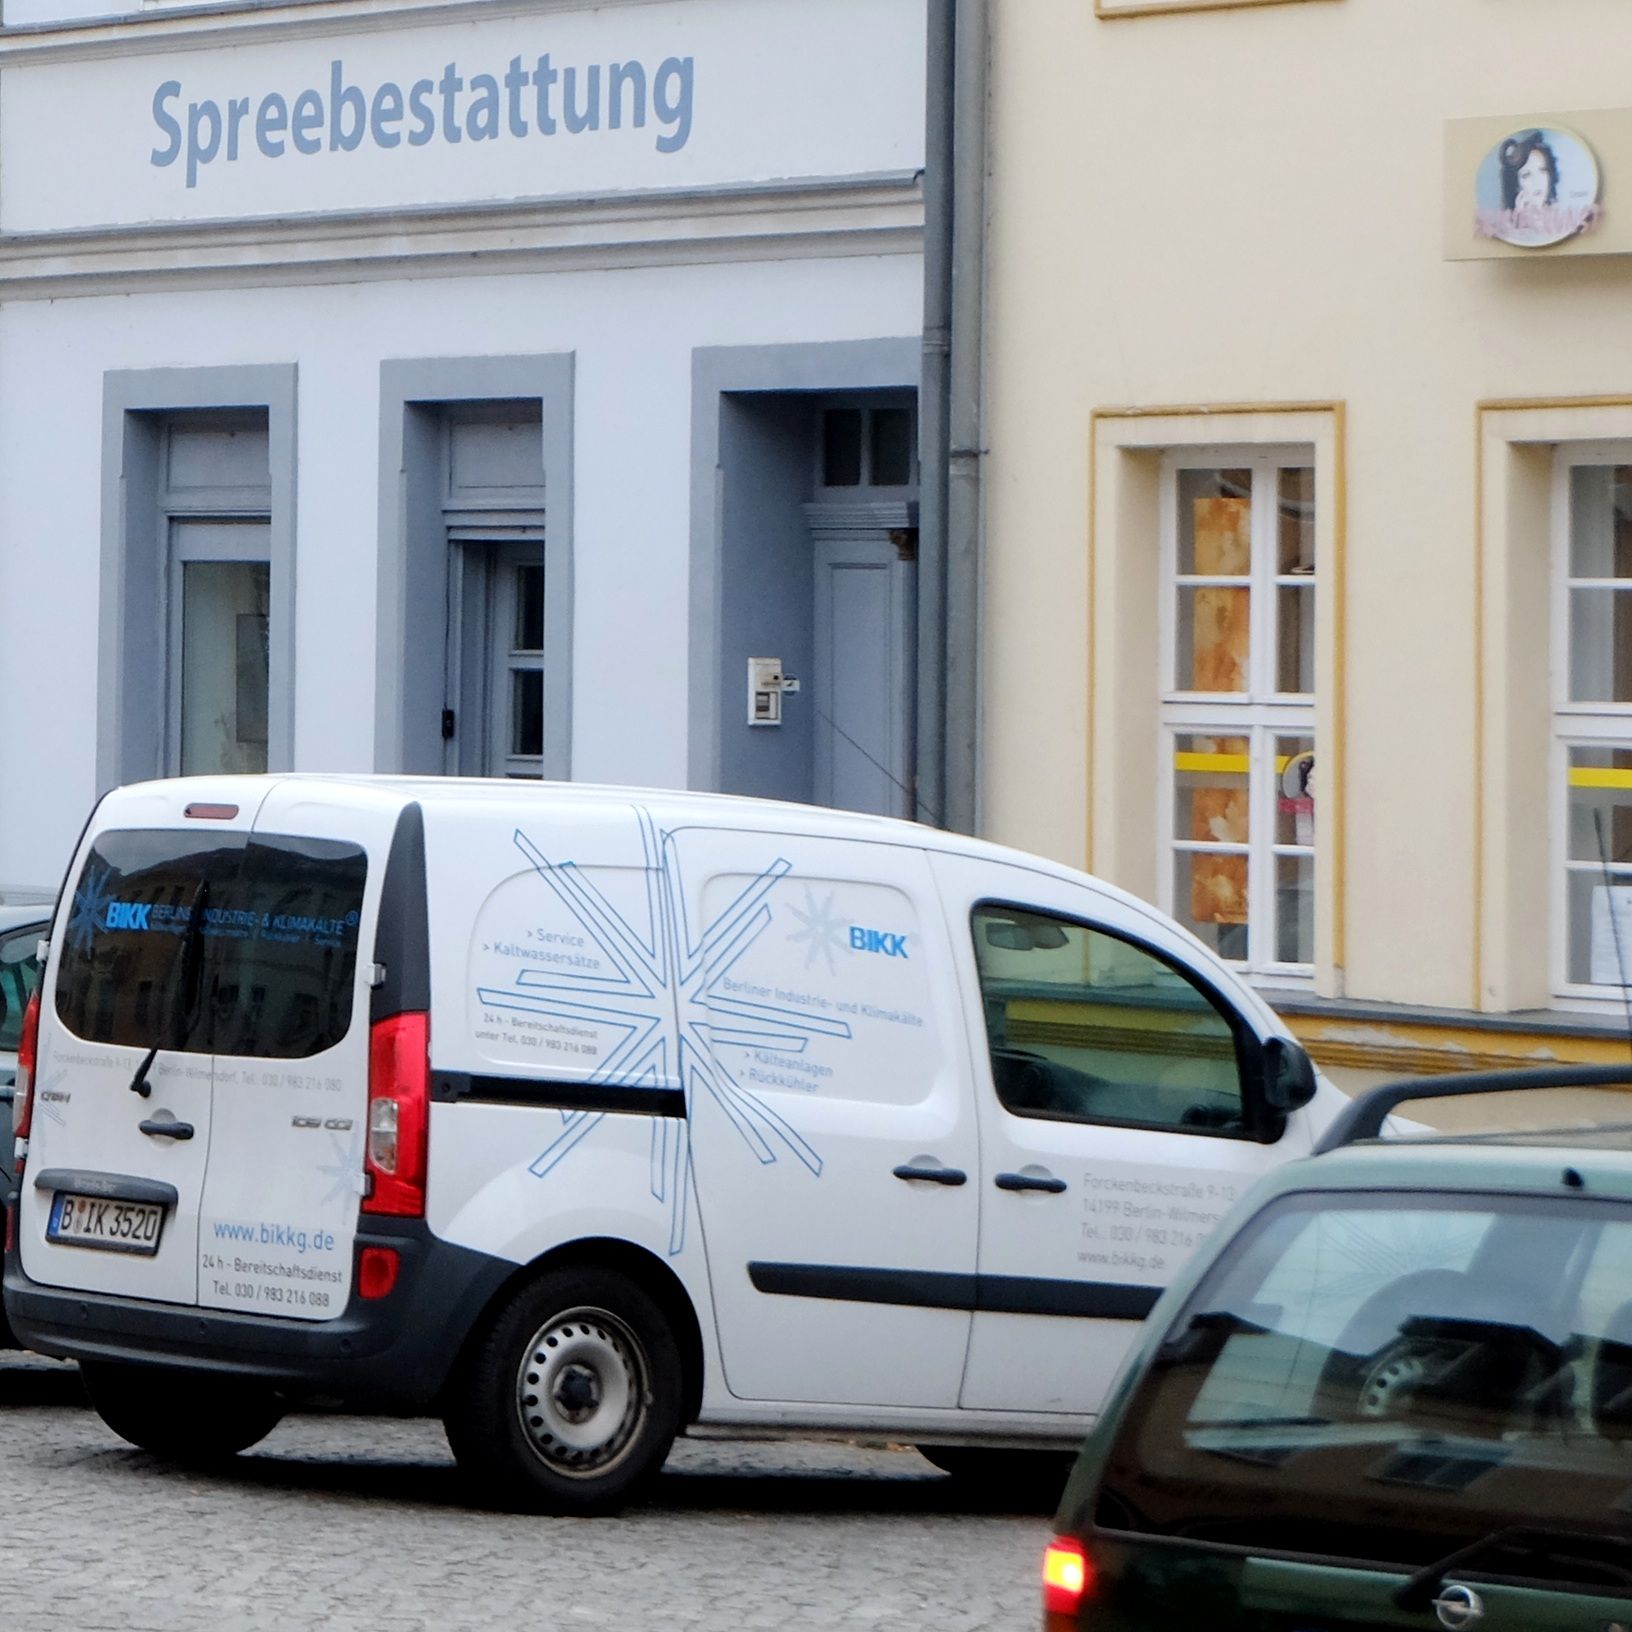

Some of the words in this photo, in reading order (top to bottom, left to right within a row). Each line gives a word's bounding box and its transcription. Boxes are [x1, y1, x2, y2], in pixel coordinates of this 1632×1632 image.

[149, 52, 694, 189] Spreebestattung
[106, 901, 152, 930] BIKK
[151, 904, 194, 921] BERLINE
[536, 927, 584, 948] Service
[849, 925, 909, 959] BIKK
[493, 941, 600, 969] Kaltwassersätze
[722, 976, 772, 998] Berliner
[775, 987, 833, 1009] Industrie-
[836, 1000, 857, 1014] und
[860, 1001, 924, 1028] Klimakälte
[475, 1029, 499, 1041] unter
[520, 1034, 537, 1047] 030
[482, 1012, 494, 1024] 24
[511, 1016, 598, 1040] Bereitschaftsdienst
[754, 1050, 834, 1078] Kälteanlagen
[749, 1067, 819, 1093] Rückkühler
[60, 1199, 74, 1230] B
[83, 1201, 110, 1235] IK
[109, 1205, 158, 1242] 3520
[1123, 1200, 1223, 1224] Berlin-Wilmers
[213, 1221, 335, 1253] www.bikkg.de
[202, 1253, 215, 1268] 24
[217, 1255, 224, 1269] h
[234, 1256, 344, 1283] Bereitschaftsdienst
[235, 1281, 254, 1299] 030
[264, 1285, 284, 1302] 983
[286, 1288, 306, 1305] 216
[308, 1290, 331, 1308] 088
